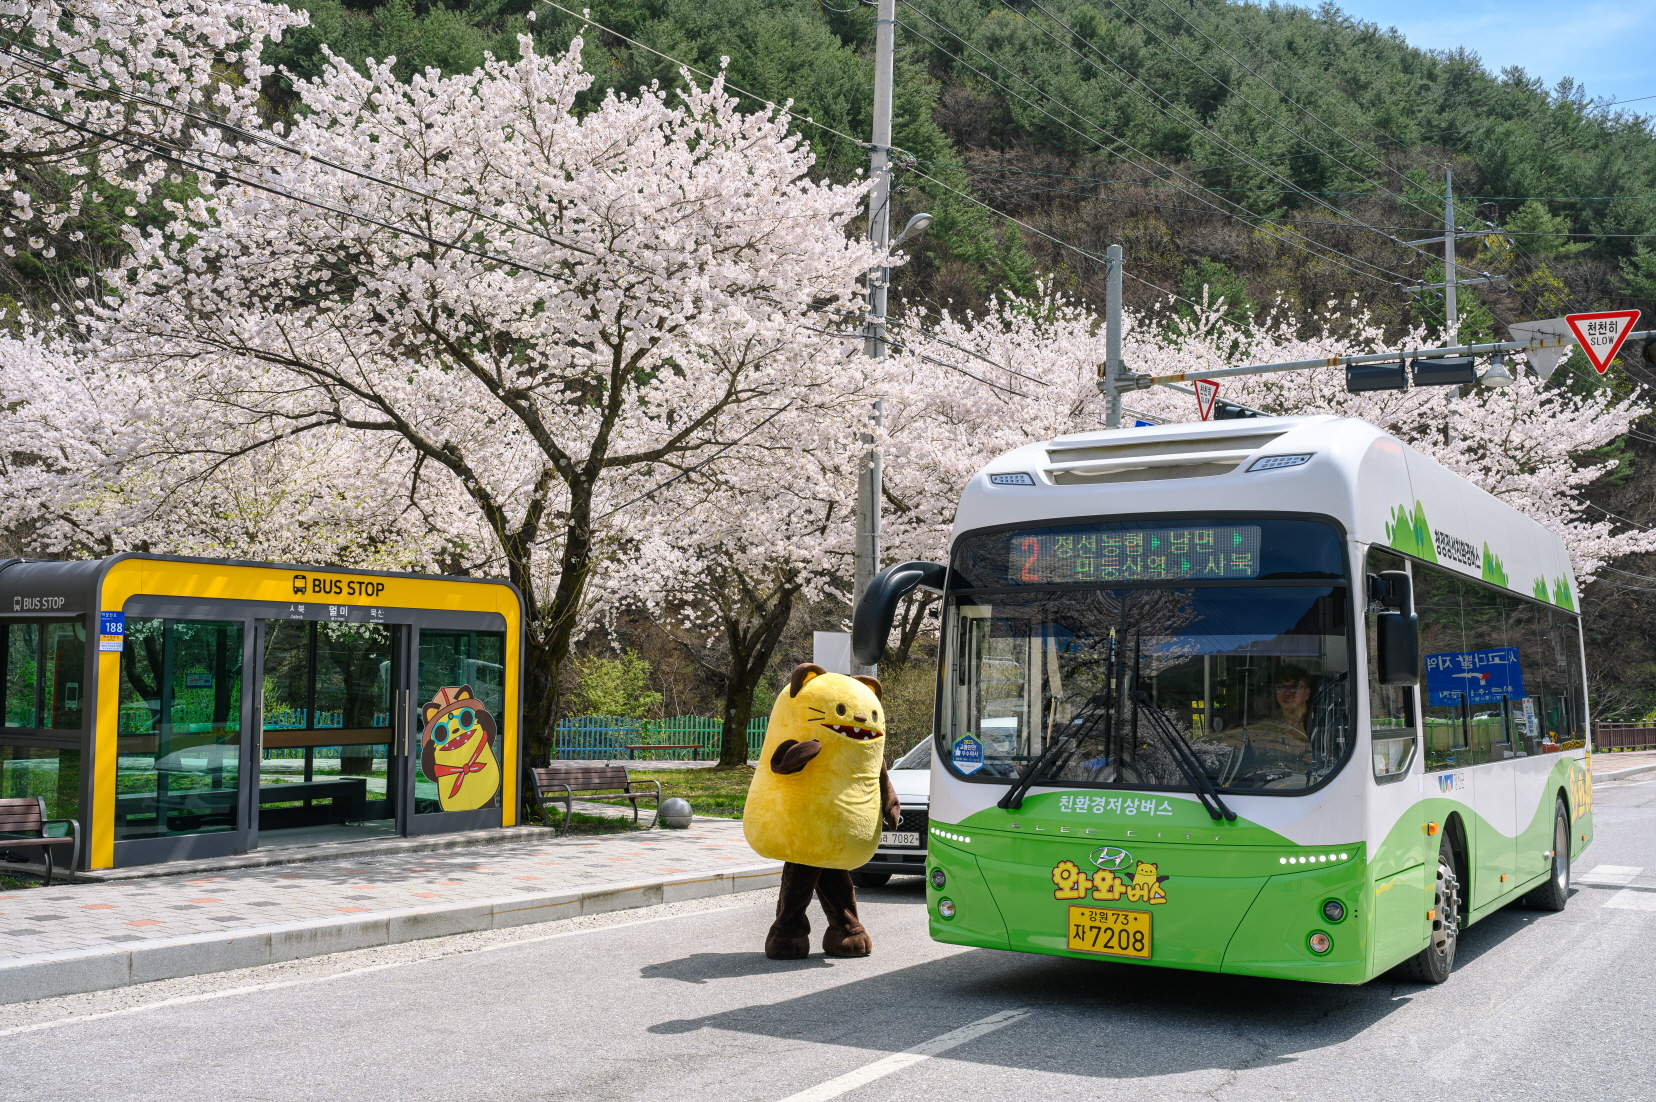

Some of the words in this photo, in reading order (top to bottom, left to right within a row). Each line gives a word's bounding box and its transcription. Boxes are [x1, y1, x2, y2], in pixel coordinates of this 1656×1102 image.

[1587, 320, 1618, 336] 천천히
[1590, 336, 1615, 346] SLOW
[1054, 532, 1143, 558] 정선농협
[1170, 529, 1214, 554] 남면
[1020, 537, 1040, 582] 2
[1076, 555, 1166, 580] 민둥산역
[1203, 552, 1253, 576] 사북
[312, 578, 343, 595] BUS
[347, 580, 385, 597] STOP
[23, 597, 40, 610] BUS
[42, 596, 65, 609] STOP
[106, 622, 123, 633] 188
[1058, 795, 1173, 817] 친환경저상버스
[891, 833, 915, 844] 7082
[1011, 822, 1097, 835] ELEC
[1126, 830, 1223, 841] CITY
[1051, 860, 1168, 905] 와와버스
[1088, 910, 1108, 924] 강원
[1111, 912, 1130, 926] 73
